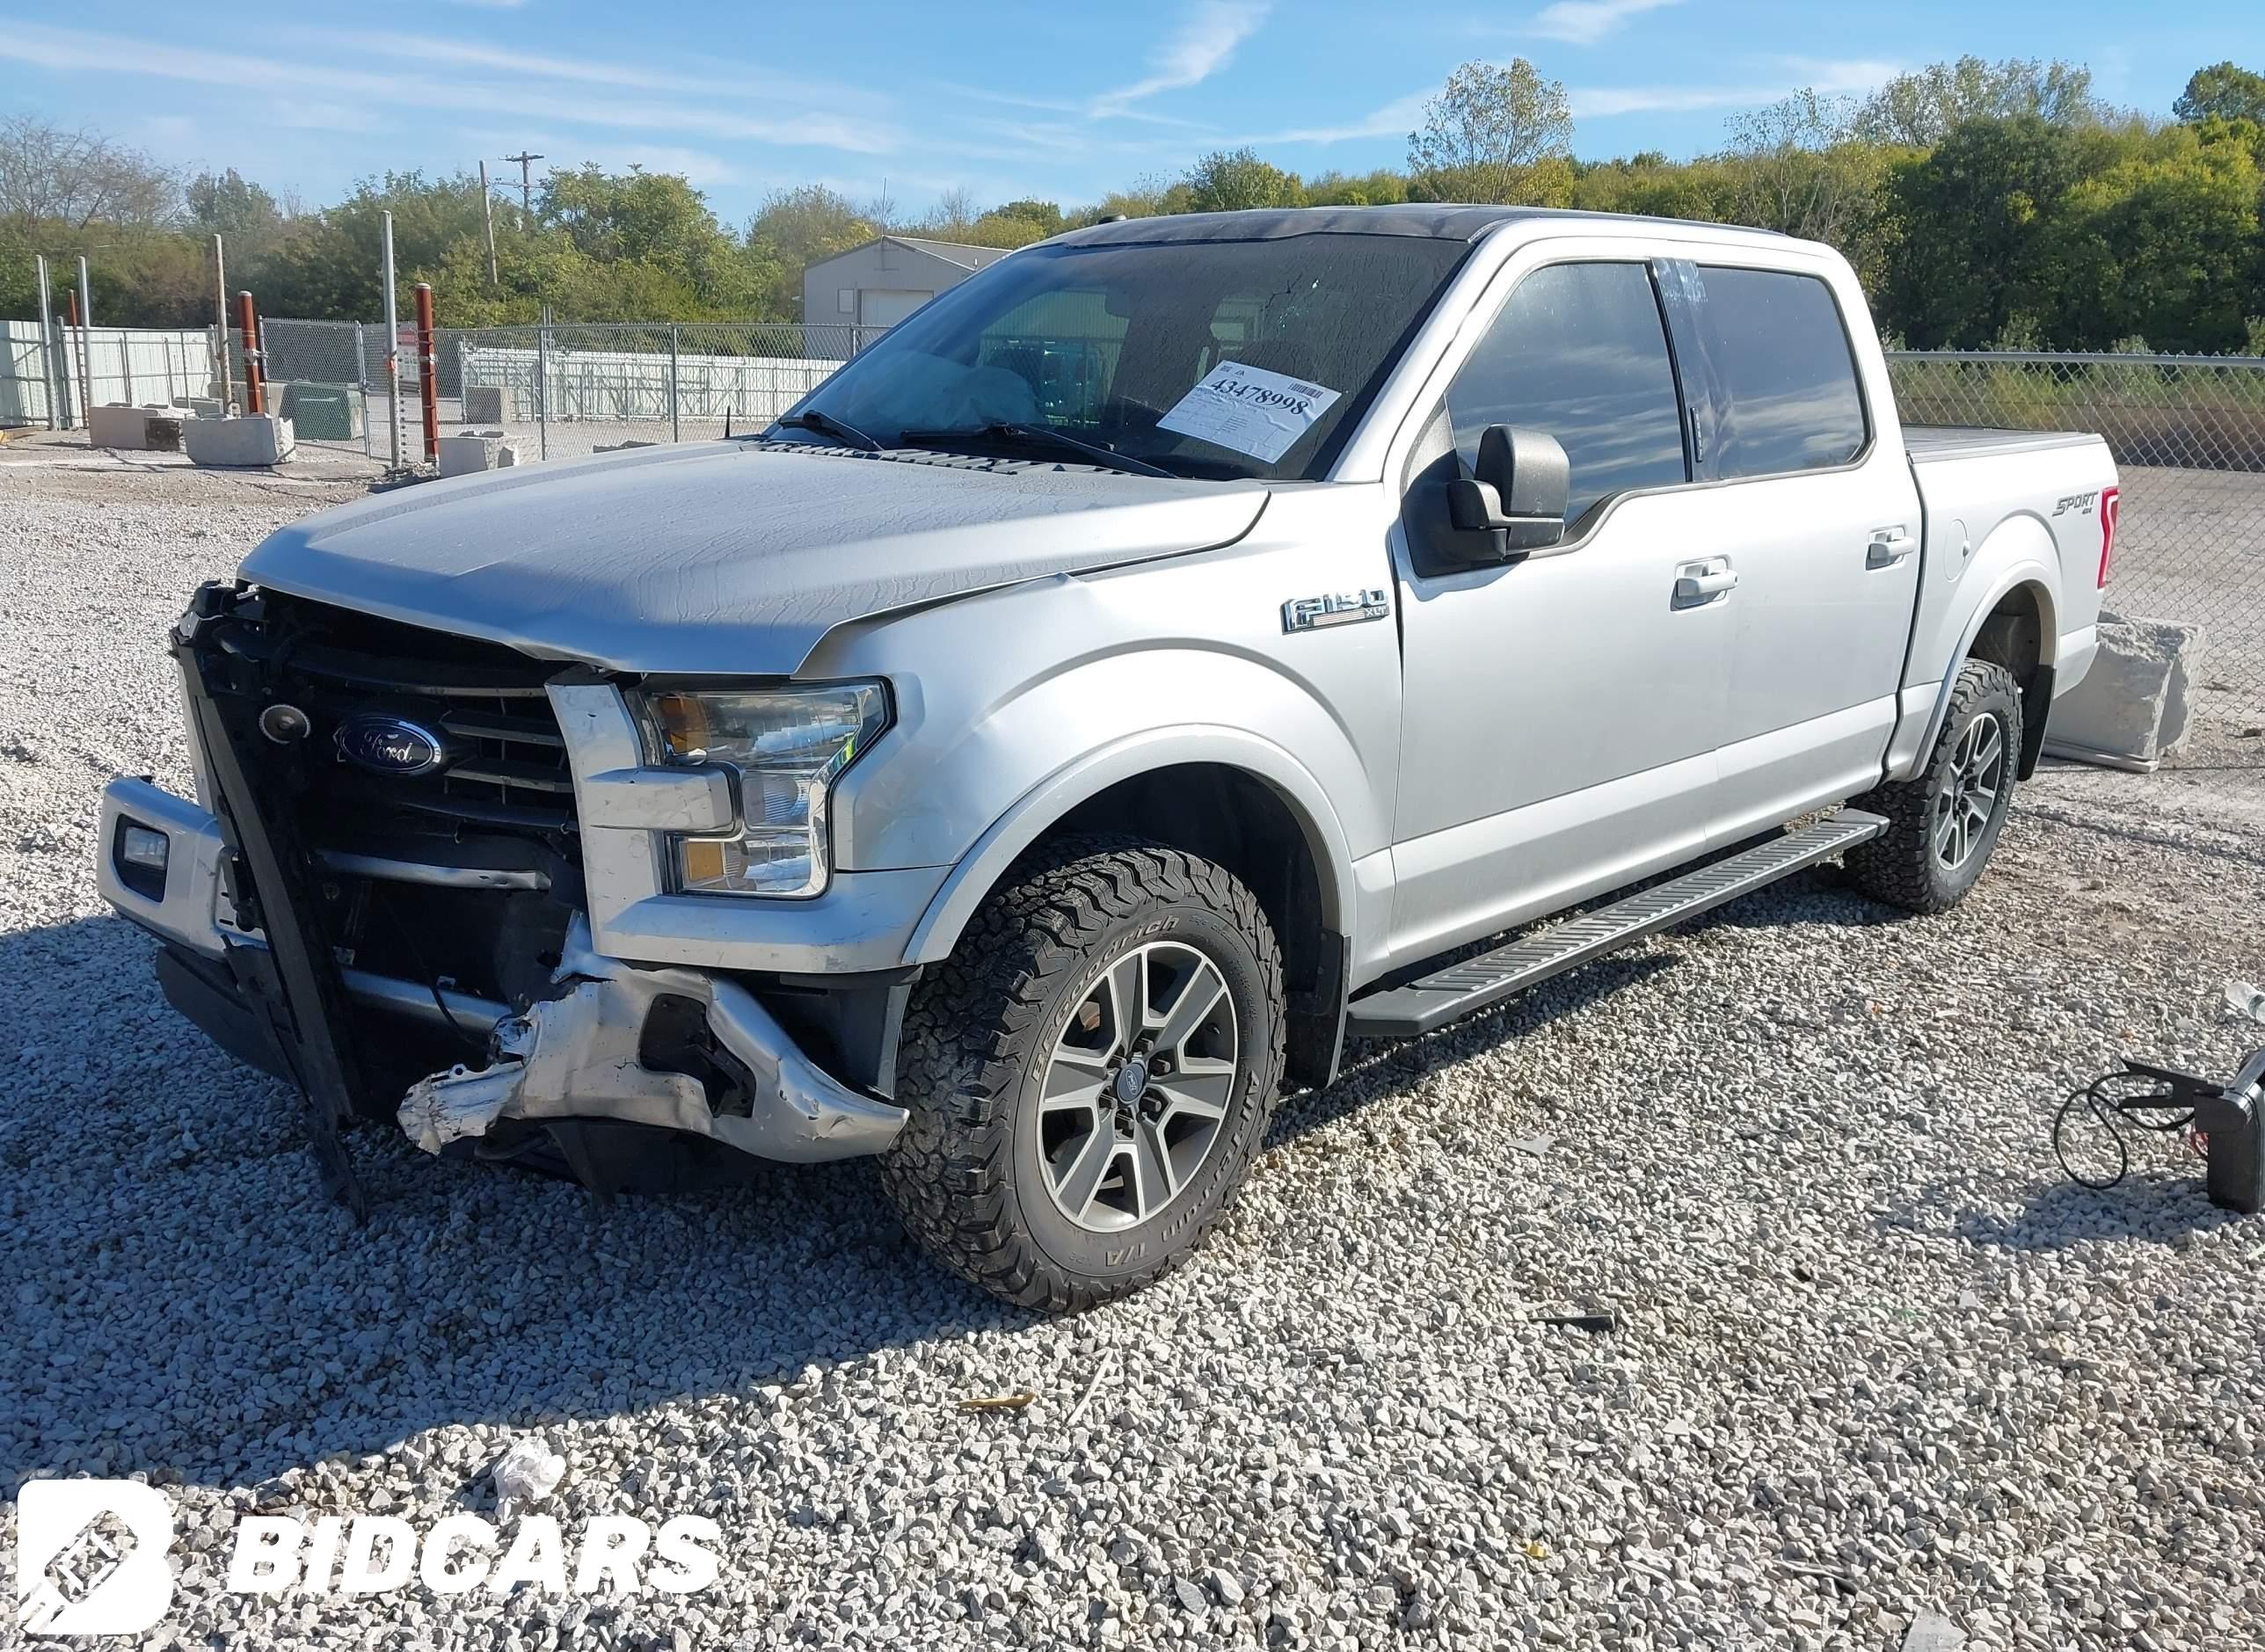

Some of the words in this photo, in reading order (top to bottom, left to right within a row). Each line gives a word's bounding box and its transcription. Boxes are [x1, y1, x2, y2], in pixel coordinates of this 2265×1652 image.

[1212, 379, 1309, 415] 43478998
[2053, 491, 2098, 516] SPORT
[1365, 607, 1387, 617] XLT
[361, 732, 412, 762] Ford
